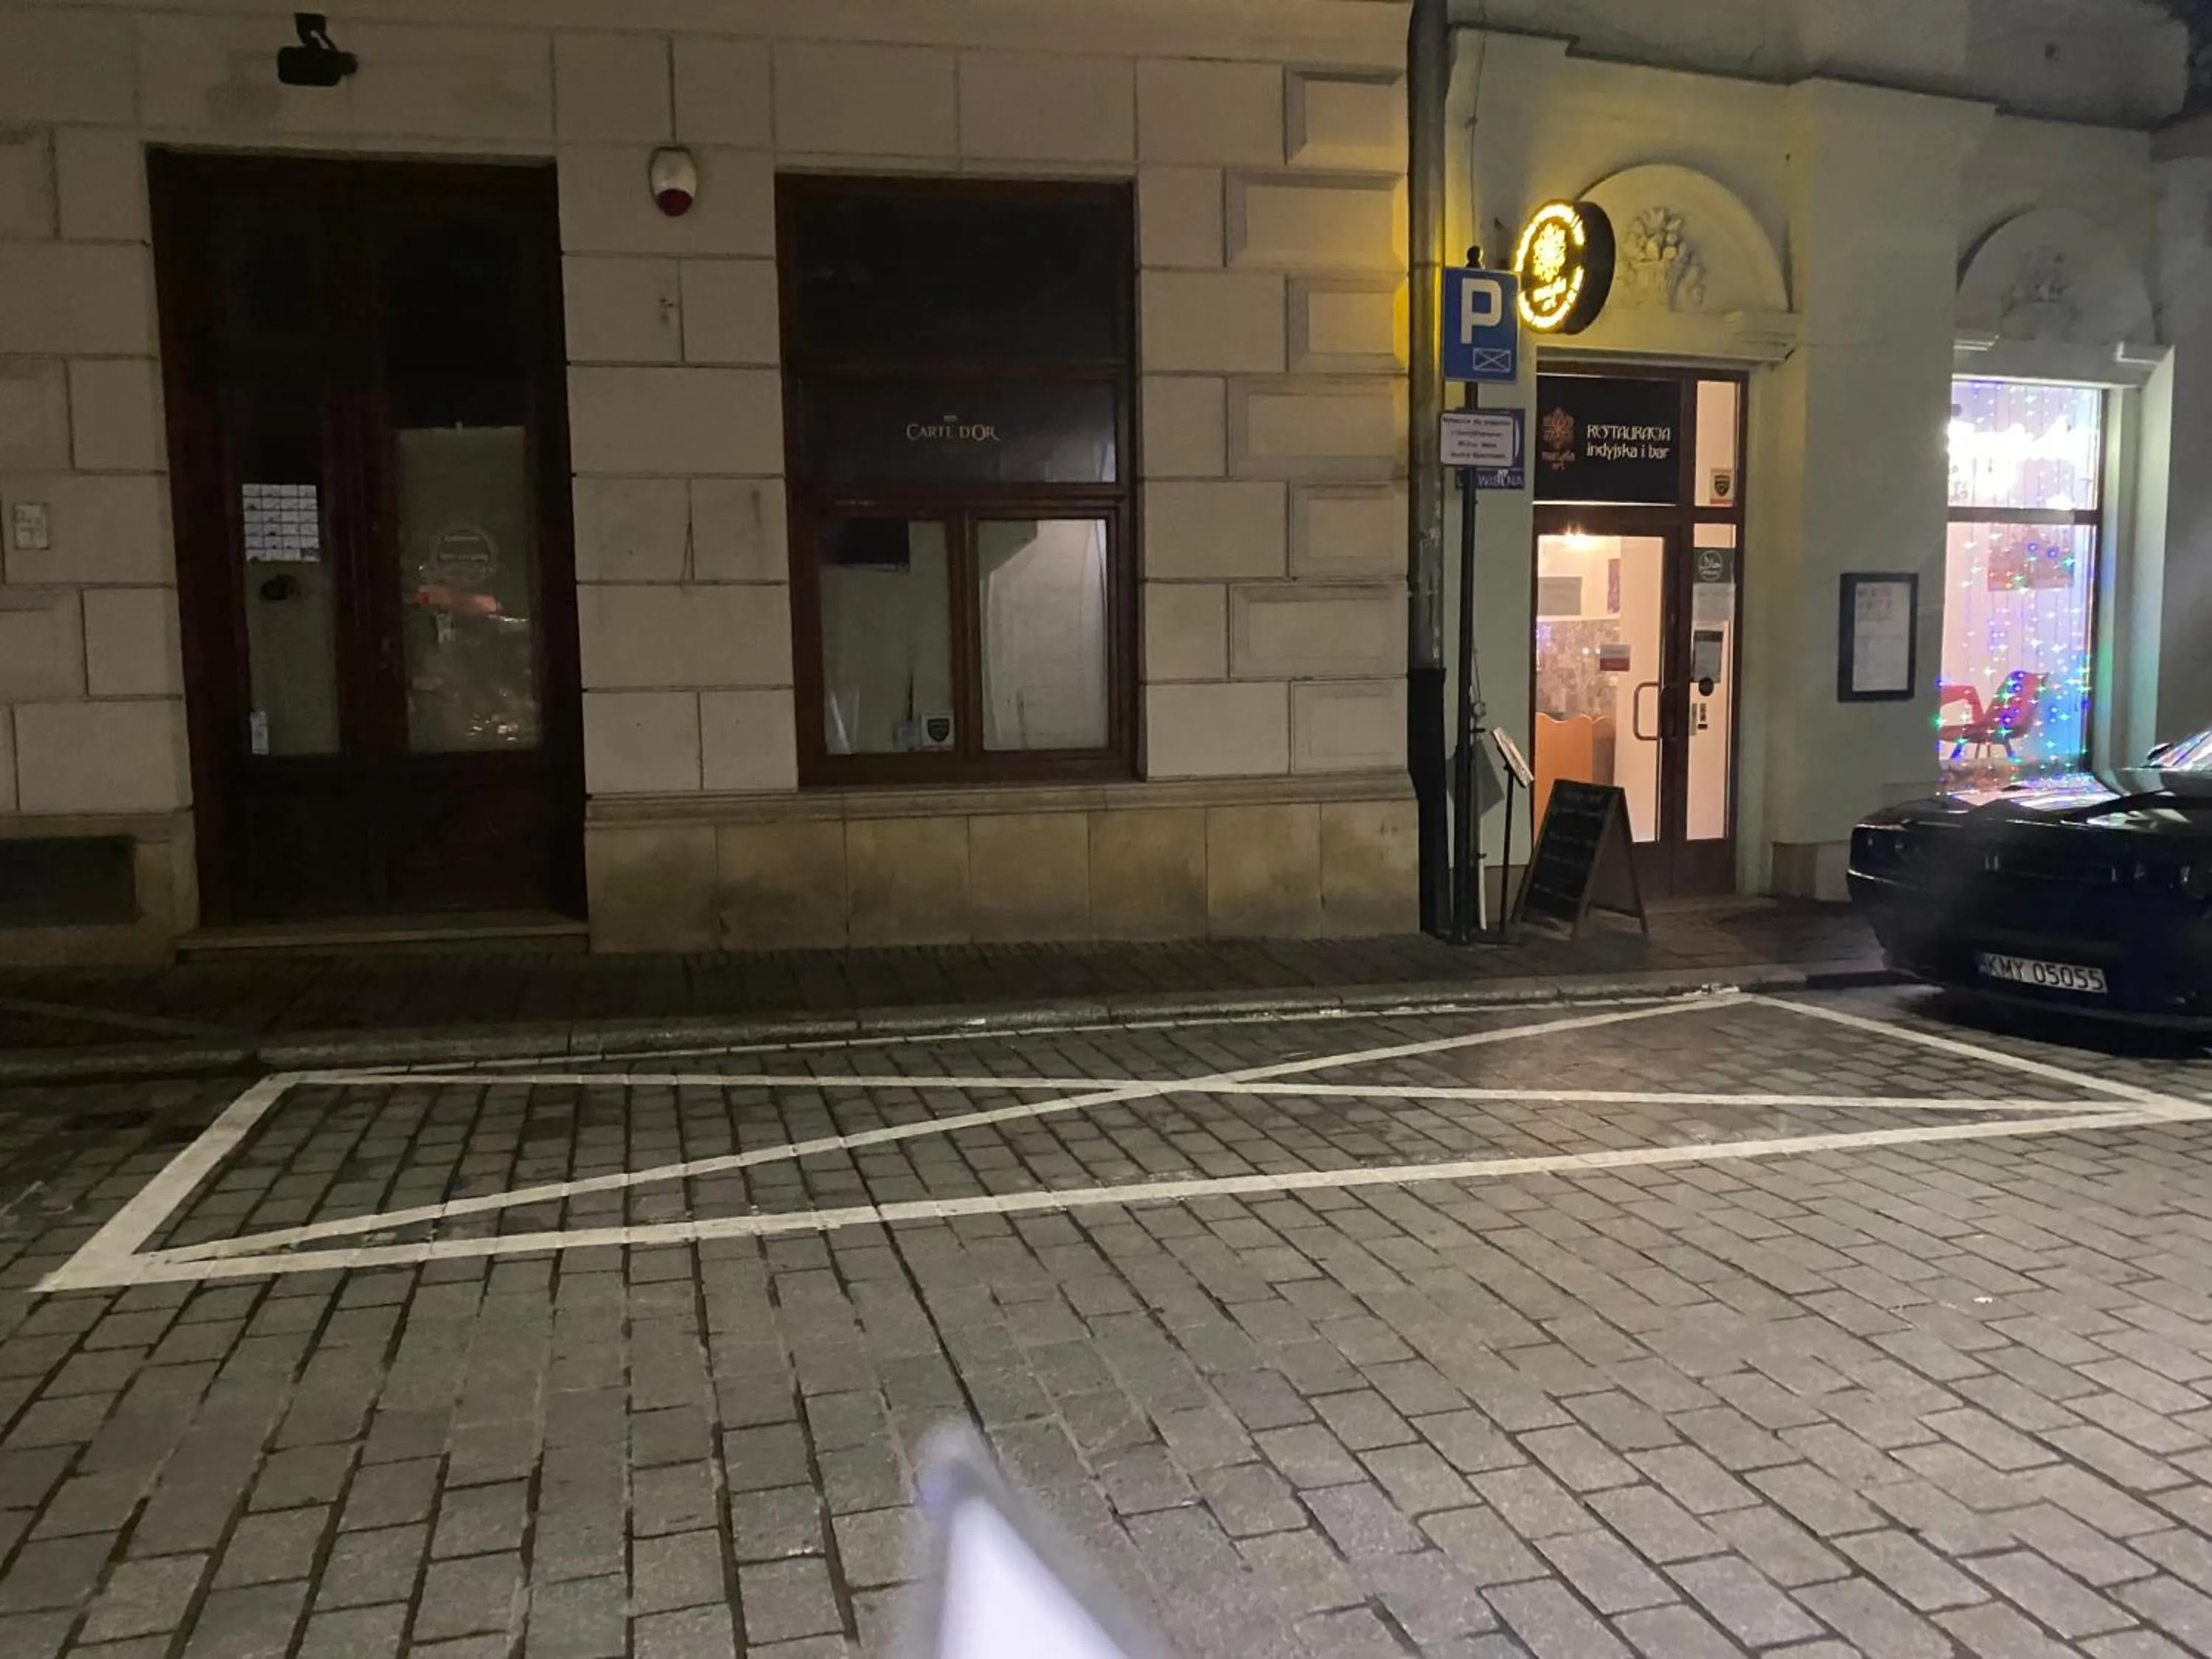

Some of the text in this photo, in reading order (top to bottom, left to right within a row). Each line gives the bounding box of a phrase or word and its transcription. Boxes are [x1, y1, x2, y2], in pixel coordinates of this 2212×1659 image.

[1461, 278, 1502, 344] P
[906, 424, 952, 441] CARTE
[1587, 442, 1670, 460] indyjska i bar
[1987, 956, 2104, 990] KMY 05055
